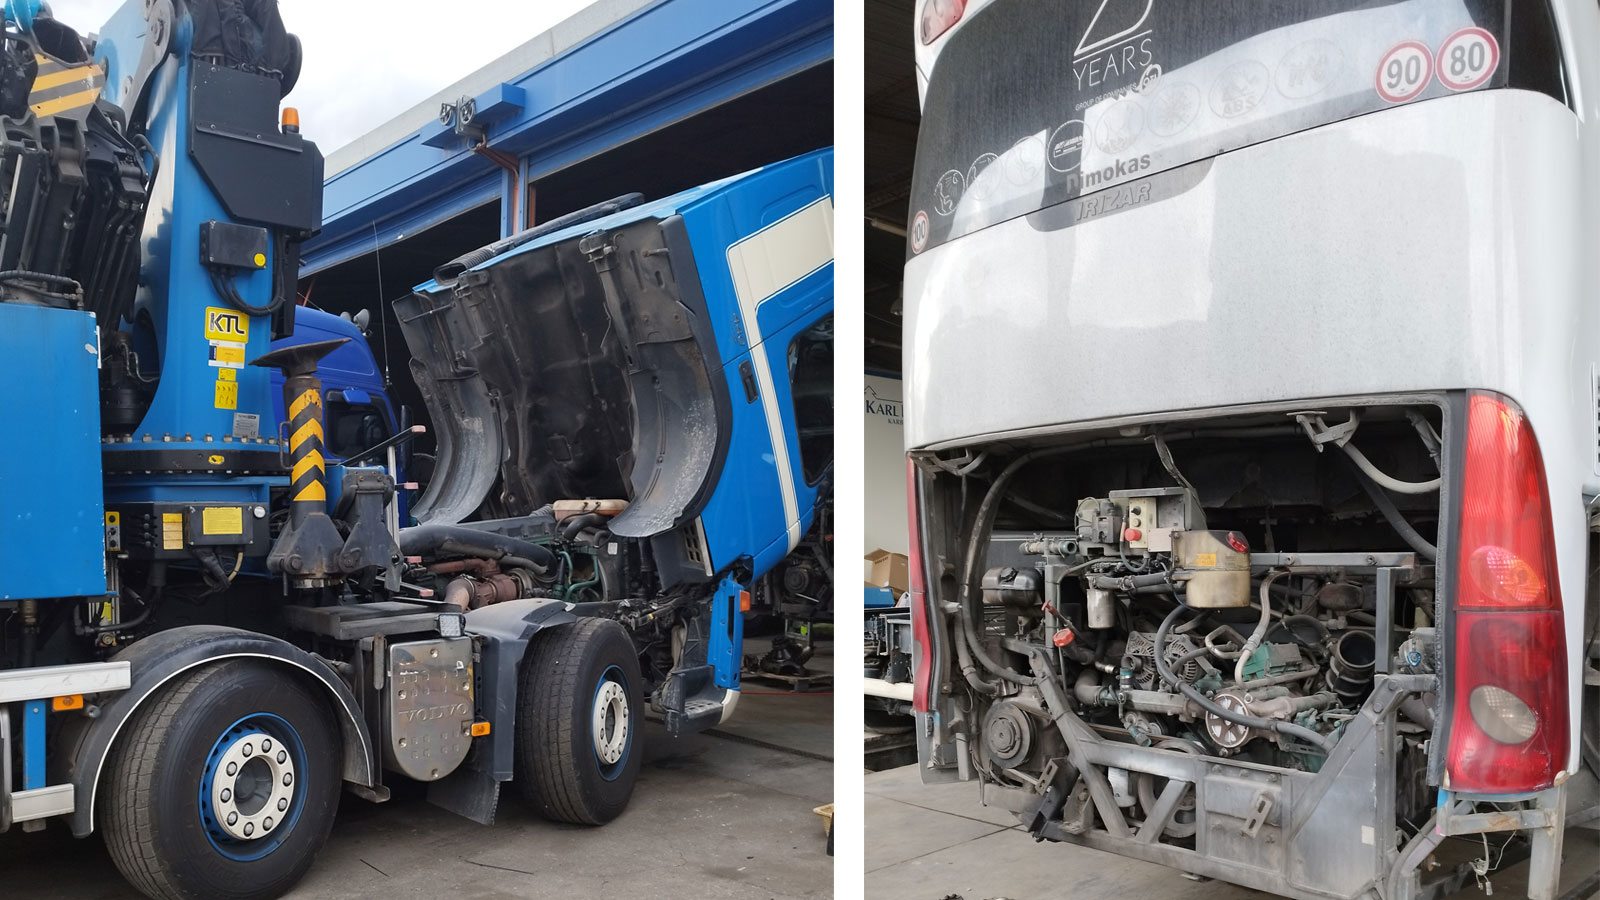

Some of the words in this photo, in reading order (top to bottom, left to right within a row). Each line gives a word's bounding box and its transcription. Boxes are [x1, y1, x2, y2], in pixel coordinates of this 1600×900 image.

[1073, 38, 1152, 91] YEARS
[1387, 55, 1421, 89] 90
[1450, 41, 1485, 76] 80
[1076, 181, 1152, 221] IRIZAR
[914, 219, 926, 244] 100
[209, 312, 246, 335] KTL
[866, 399, 899, 417] KARL
[398, 703, 468, 721] VOLVO
